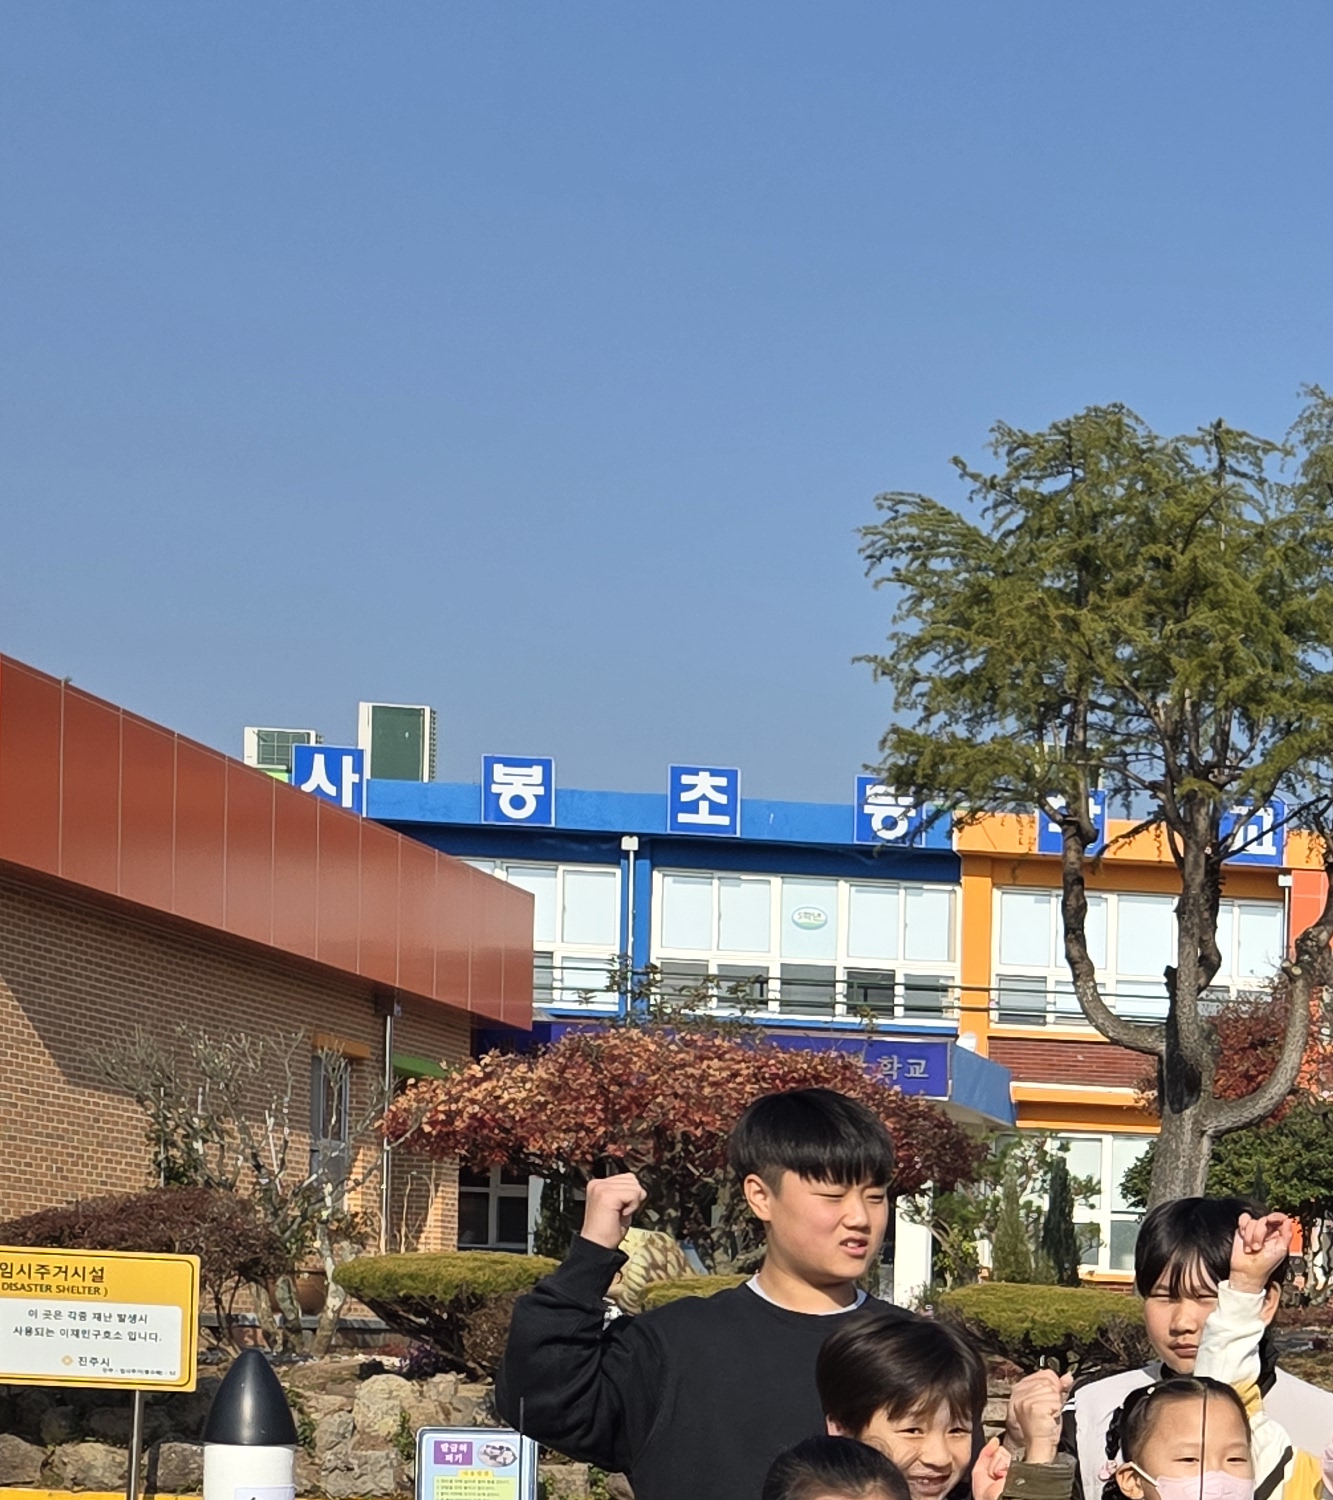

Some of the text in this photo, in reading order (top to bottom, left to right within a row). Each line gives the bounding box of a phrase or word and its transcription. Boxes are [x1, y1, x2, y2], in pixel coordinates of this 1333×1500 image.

[0, 1262, 105, 1283] 임시주거시설
[1, 1281, 53, 1294] DISASTER
[55, 1284, 101, 1296] SHELTER
[28, 1308, 38, 1319] 이
[42, 1309, 63, 1321] 곳은
[77, 1356, 111, 1367] 진주시
